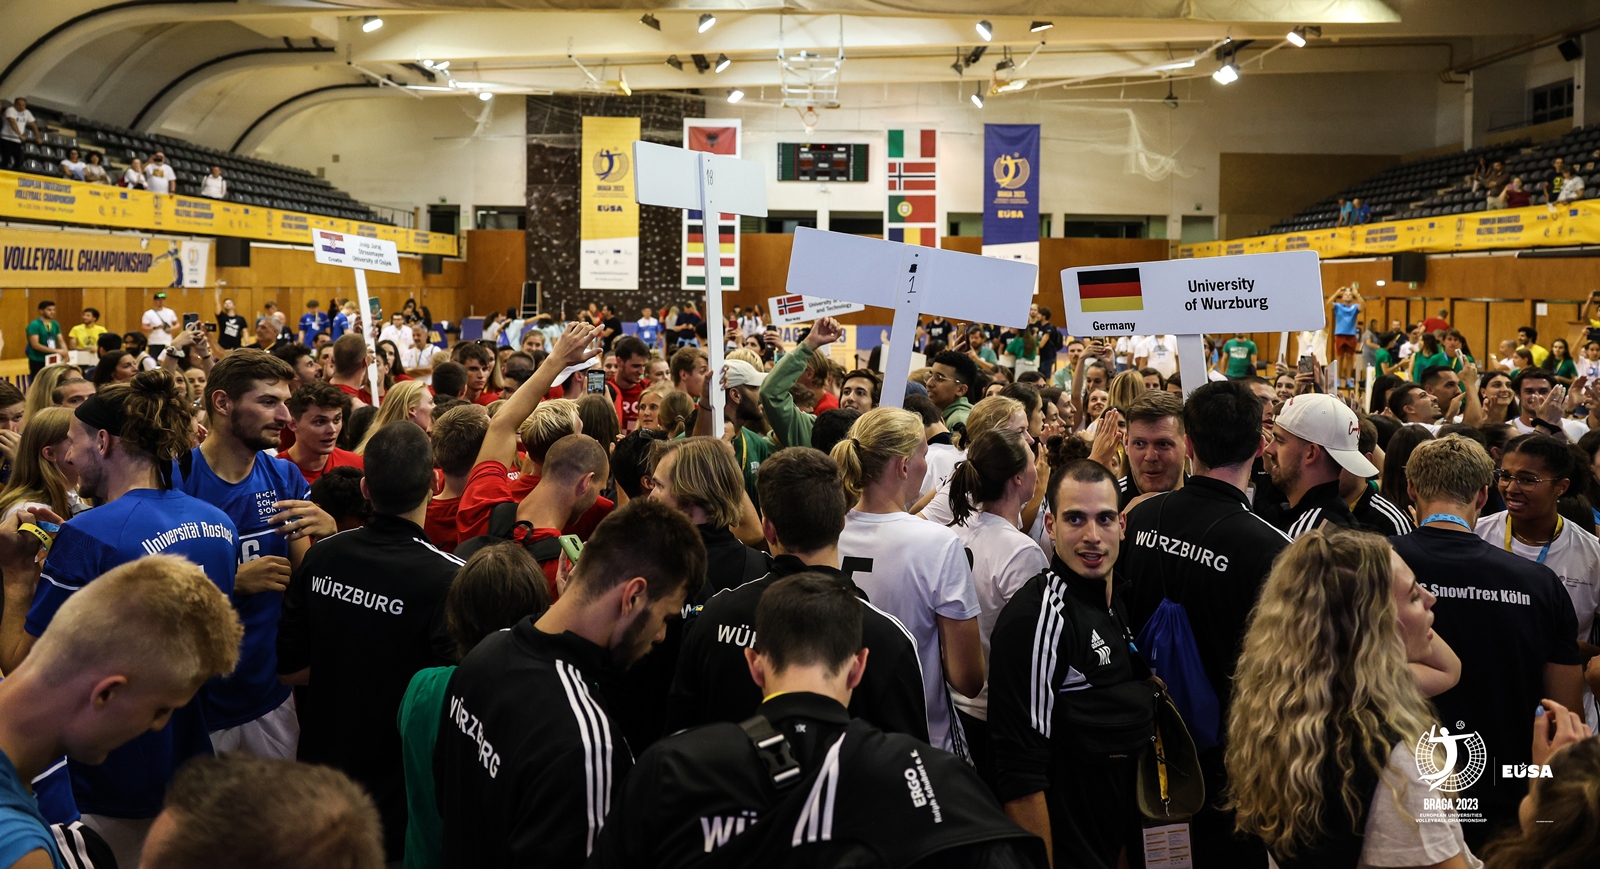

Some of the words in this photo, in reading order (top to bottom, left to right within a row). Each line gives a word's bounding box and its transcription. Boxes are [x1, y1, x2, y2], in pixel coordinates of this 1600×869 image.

[3, 246, 74, 271] VOLLEYBALL
[77, 249, 153, 273] CHAMPIONSHIP
[352, 255, 373, 265] University
[1187, 277, 1255, 293] University
[808, 299, 832, 308] University
[826, 303, 852, 312] Technology
[1184, 298, 1198, 311] of
[1200, 296, 1269, 311] Wurzburg
[1092, 321, 1136, 331] Germany
[141, 521, 201, 556] Universität
[200, 521, 234, 546] Rostock
[1135, 529, 1229, 572] WÜRZBURG
[311, 575, 404, 615] WÜRZBURG
[1430, 583, 1499, 602] SnowTrex
[1500, 589, 1531, 606] Köln
[904, 767, 927, 808] ERGO
[929, 798, 943, 824] Ralph
